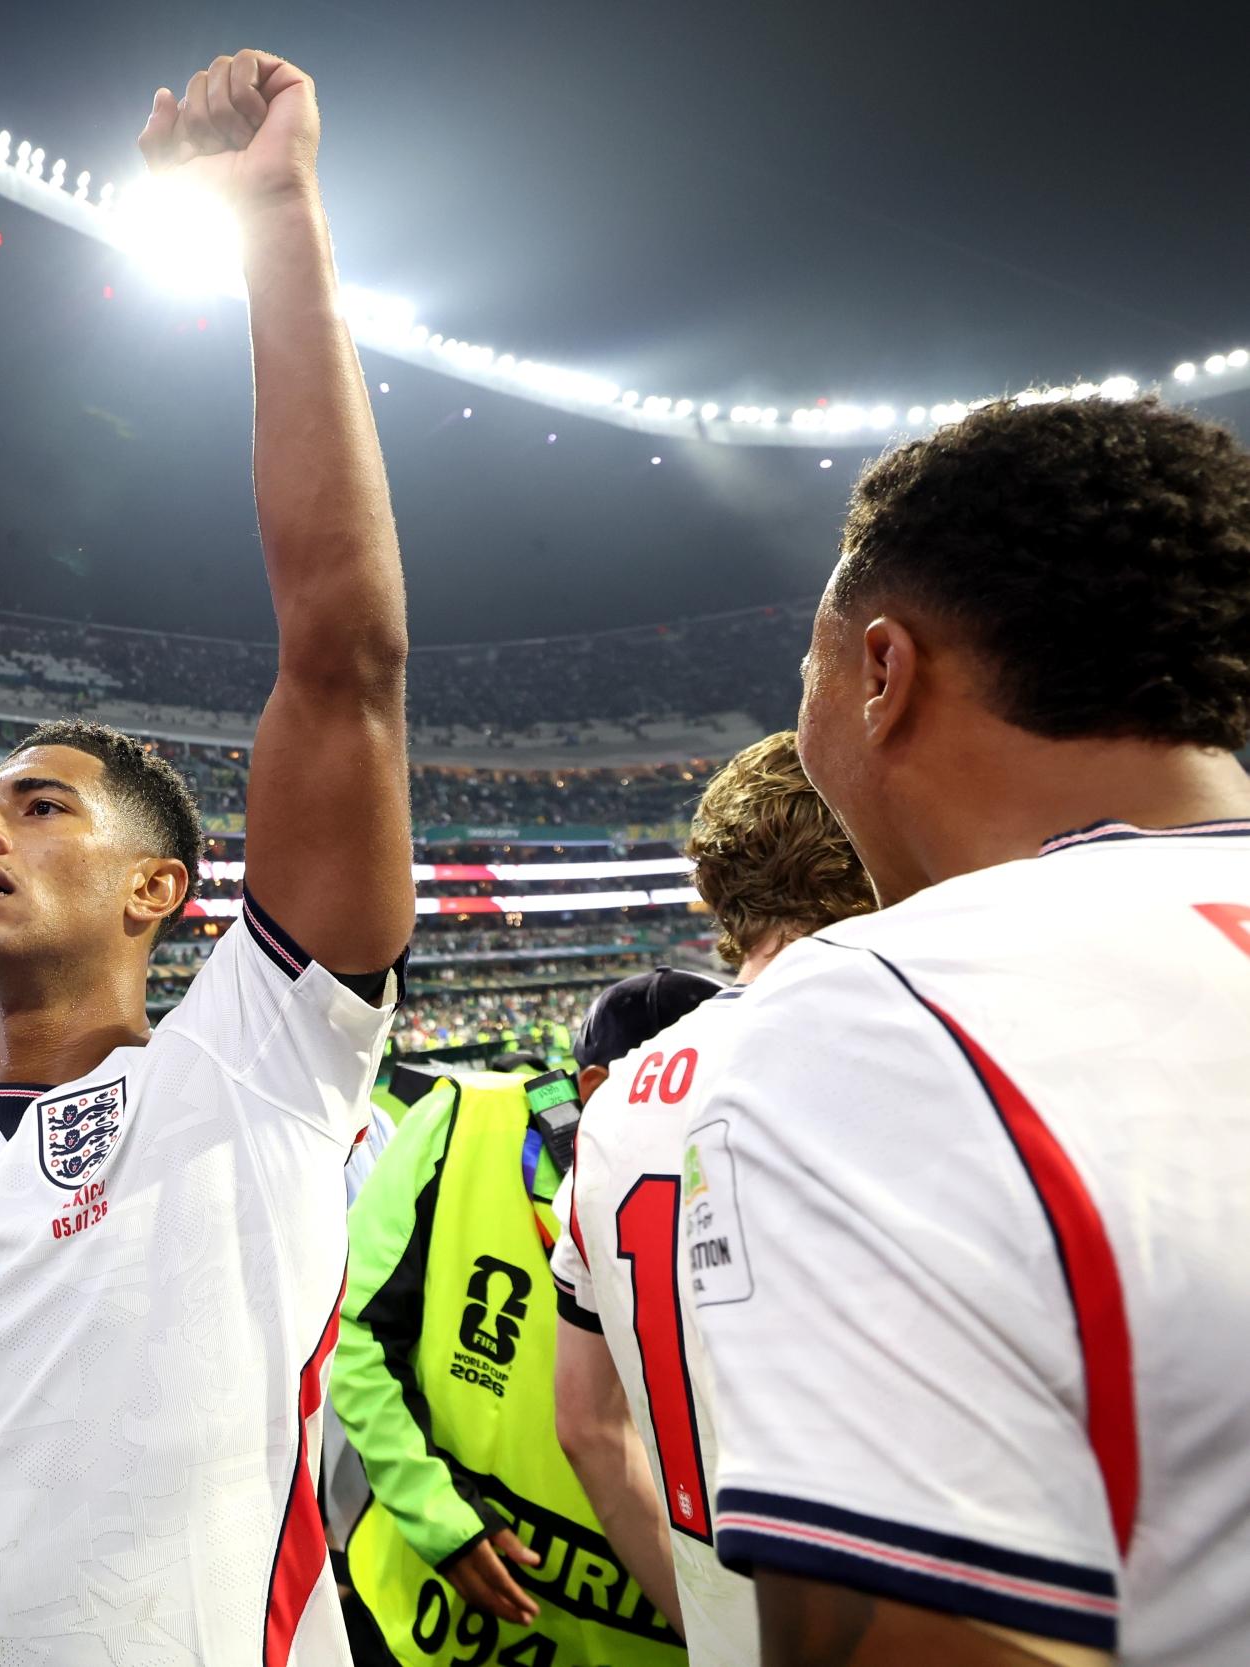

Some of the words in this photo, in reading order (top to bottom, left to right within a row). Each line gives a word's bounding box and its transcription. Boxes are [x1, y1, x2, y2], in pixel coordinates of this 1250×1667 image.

[52, 1200, 108, 1240] 05.07.26
[473, 1332, 498, 1355] FIFA
[450, 1363, 506, 1398] 2026
[454, 1351, 490, 1372] WORLD
[490, 1366, 509, 1382] CUP
